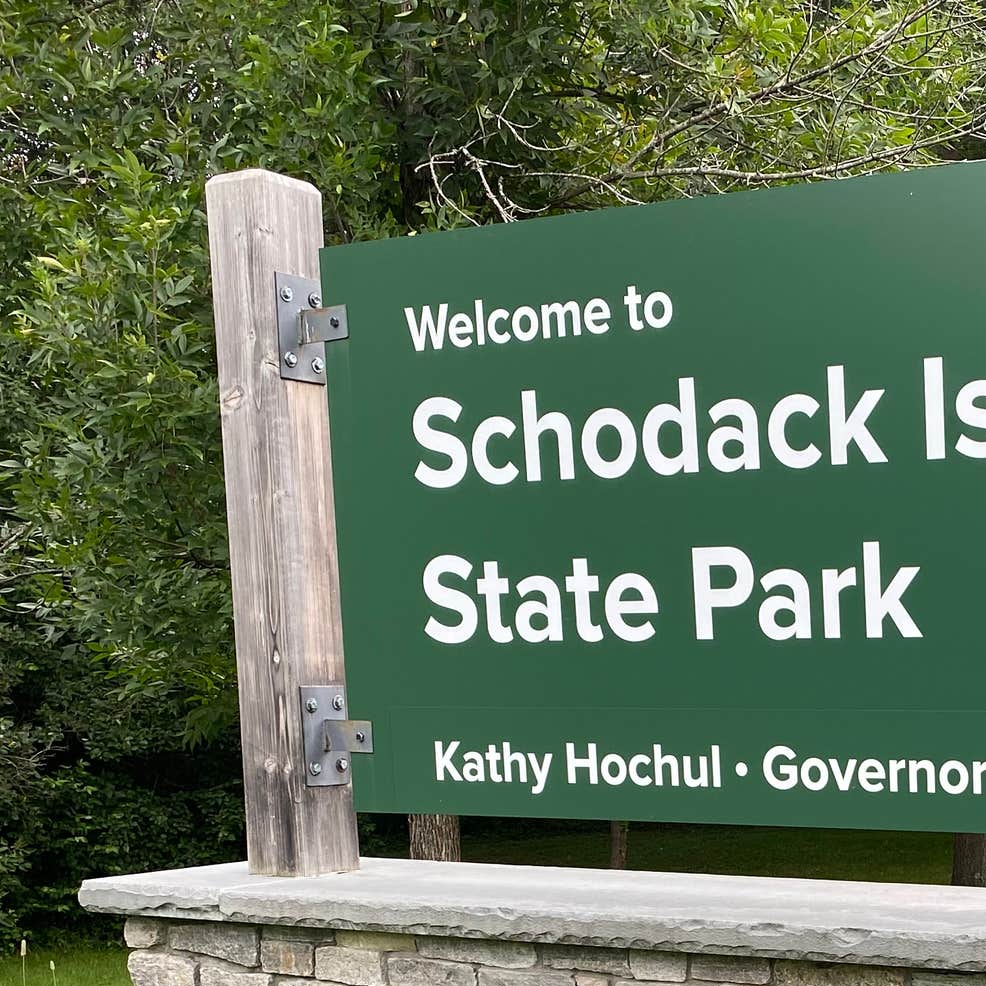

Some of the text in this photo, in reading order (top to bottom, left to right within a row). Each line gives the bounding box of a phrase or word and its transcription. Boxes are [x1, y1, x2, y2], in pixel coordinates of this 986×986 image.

[403, 285, 674, 352] Welcome to
[412, 364, 889, 489] Schodack
[422, 541, 924, 644] State Park
[434, 740, 553, 795] Kathy
[565, 742, 722, 788] Hochul
